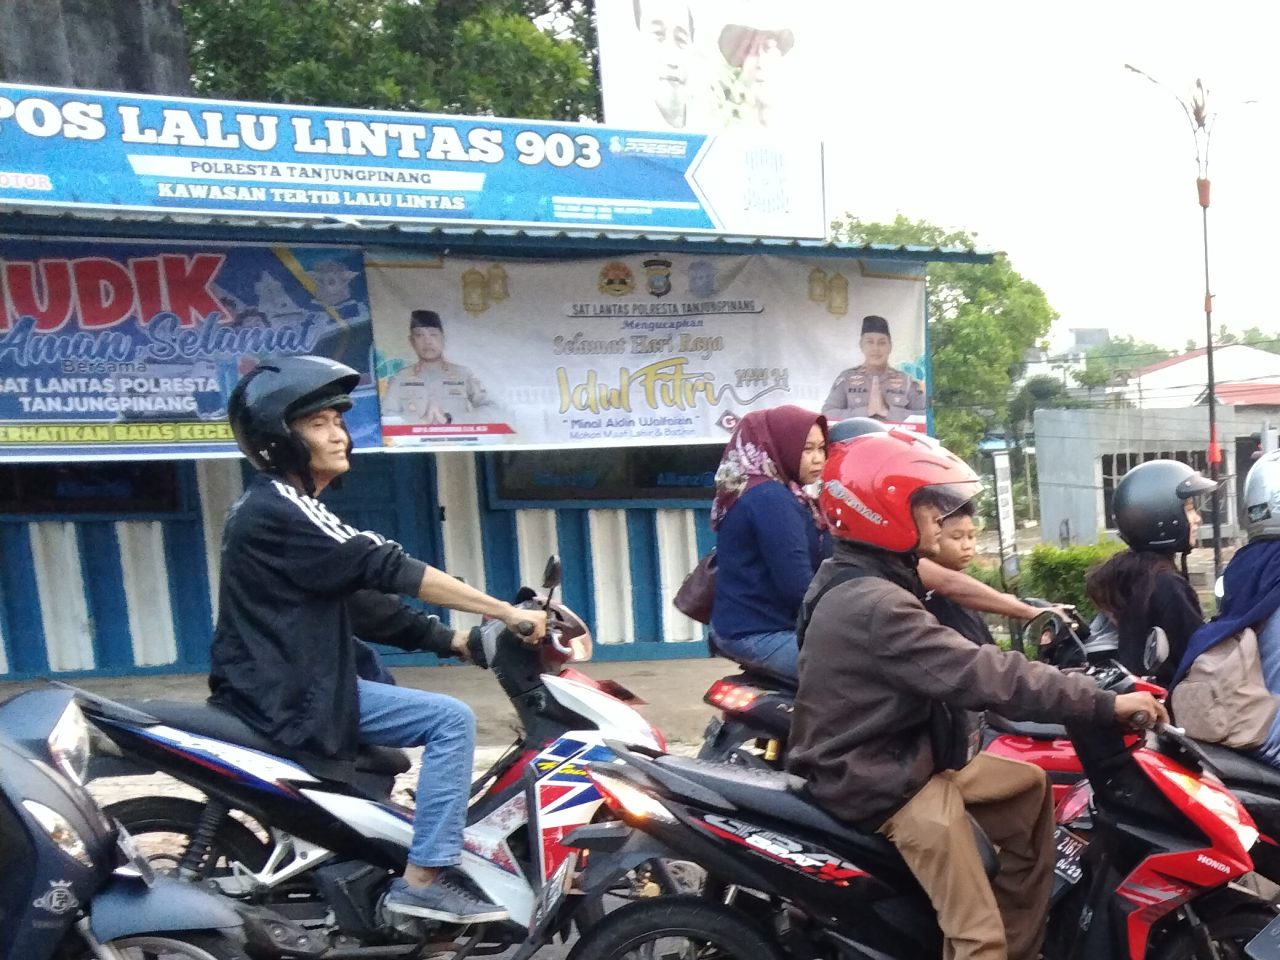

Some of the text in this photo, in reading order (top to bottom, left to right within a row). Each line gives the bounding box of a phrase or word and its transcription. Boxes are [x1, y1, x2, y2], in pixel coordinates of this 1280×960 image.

[117, 105, 278, 151] LALU
[292, 117, 505, 164] LINTAS
[515, 130, 602, 169] 903
[190, 161, 432, 184] POLRESTA TANJUNGPINANG
[157, 182, 466, 210] KAWASAN TERTIB LALU LINTAS
[572, 300, 756, 316] SAT LANTAS POLRESTA TANJUNGPINANG
[620, 319, 705, 333] Mengucapkan
[135, 311, 324, 361] Selamat
[62, 358, 148, 374] Bersama
[35, 377, 114, 393] LANTAS
[119, 377, 221, 394] POLRESTA
[555, 366, 632, 415] Idul
[628, 356, 718, 412] Fitri
[19, 396, 198, 413] TANJUNGPINANG
[115, 425, 175, 442] BATAS
[1197, 854, 1231, 874] HONDA
